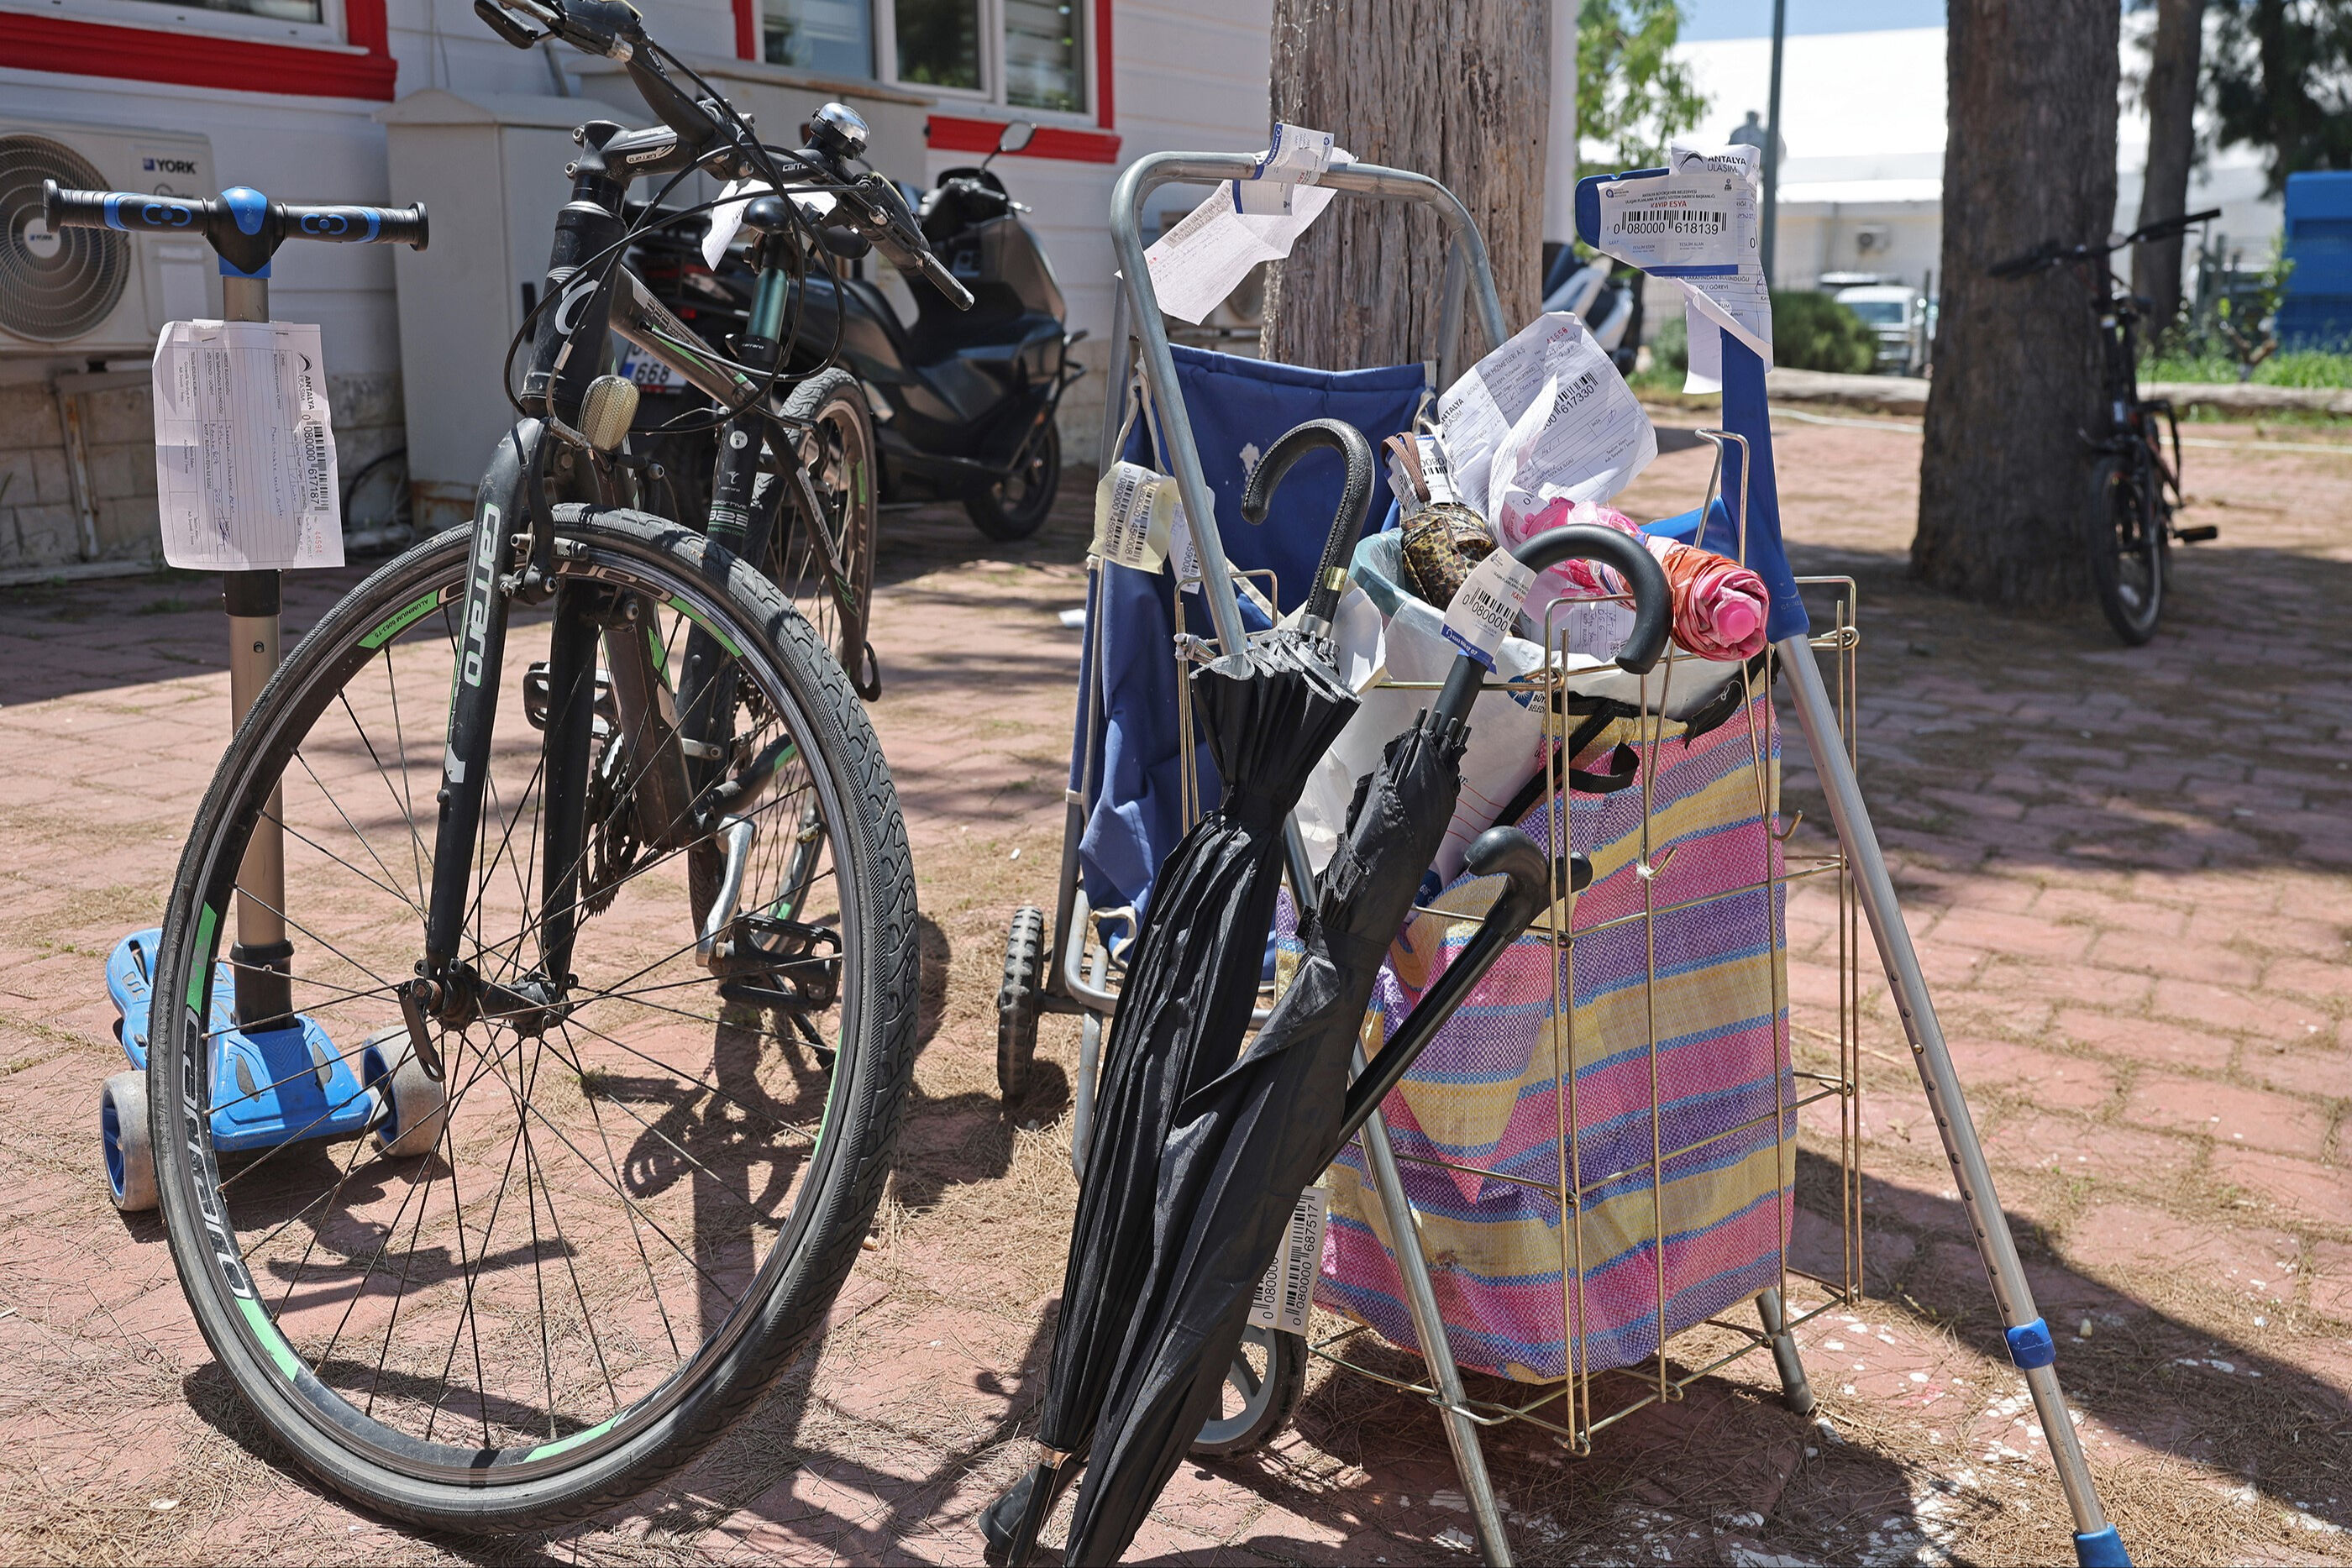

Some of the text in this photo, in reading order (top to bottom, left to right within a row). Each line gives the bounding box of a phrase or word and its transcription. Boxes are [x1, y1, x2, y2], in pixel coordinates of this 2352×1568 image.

[156, 158, 197, 175] YORK
[782, 161, 811, 172] carra
[1707, 164, 1737, 173] ULAŞIM
[1708, 155, 1746, 165] ANTALYA
[1614, 223, 1719, 235] 0 080000 618139
[304, 375, 315, 410] ANTALYA
[1560, 385, 1594, 414] 617330
[303, 427, 316, 461] 080000
[307, 469, 319, 504] 617187
[1112, 478, 1127, 510] 080000
[1134, 485, 1147, 517] 080000
[1105, 517, 1116, 548] 459008
[1126, 522, 1139, 554] 459008
[1182, 541, 1193, 572] 459008
[396, 597, 428, 621] ALUMINIUM
[465, 503, 501, 688] carraro
[1462, 594, 1507, 631] 0 080000
[182, 1011, 253, 1299] carraro
[1297, 1262, 1311, 1308] 080000
[1304, 1204, 1318, 1251] 687517
